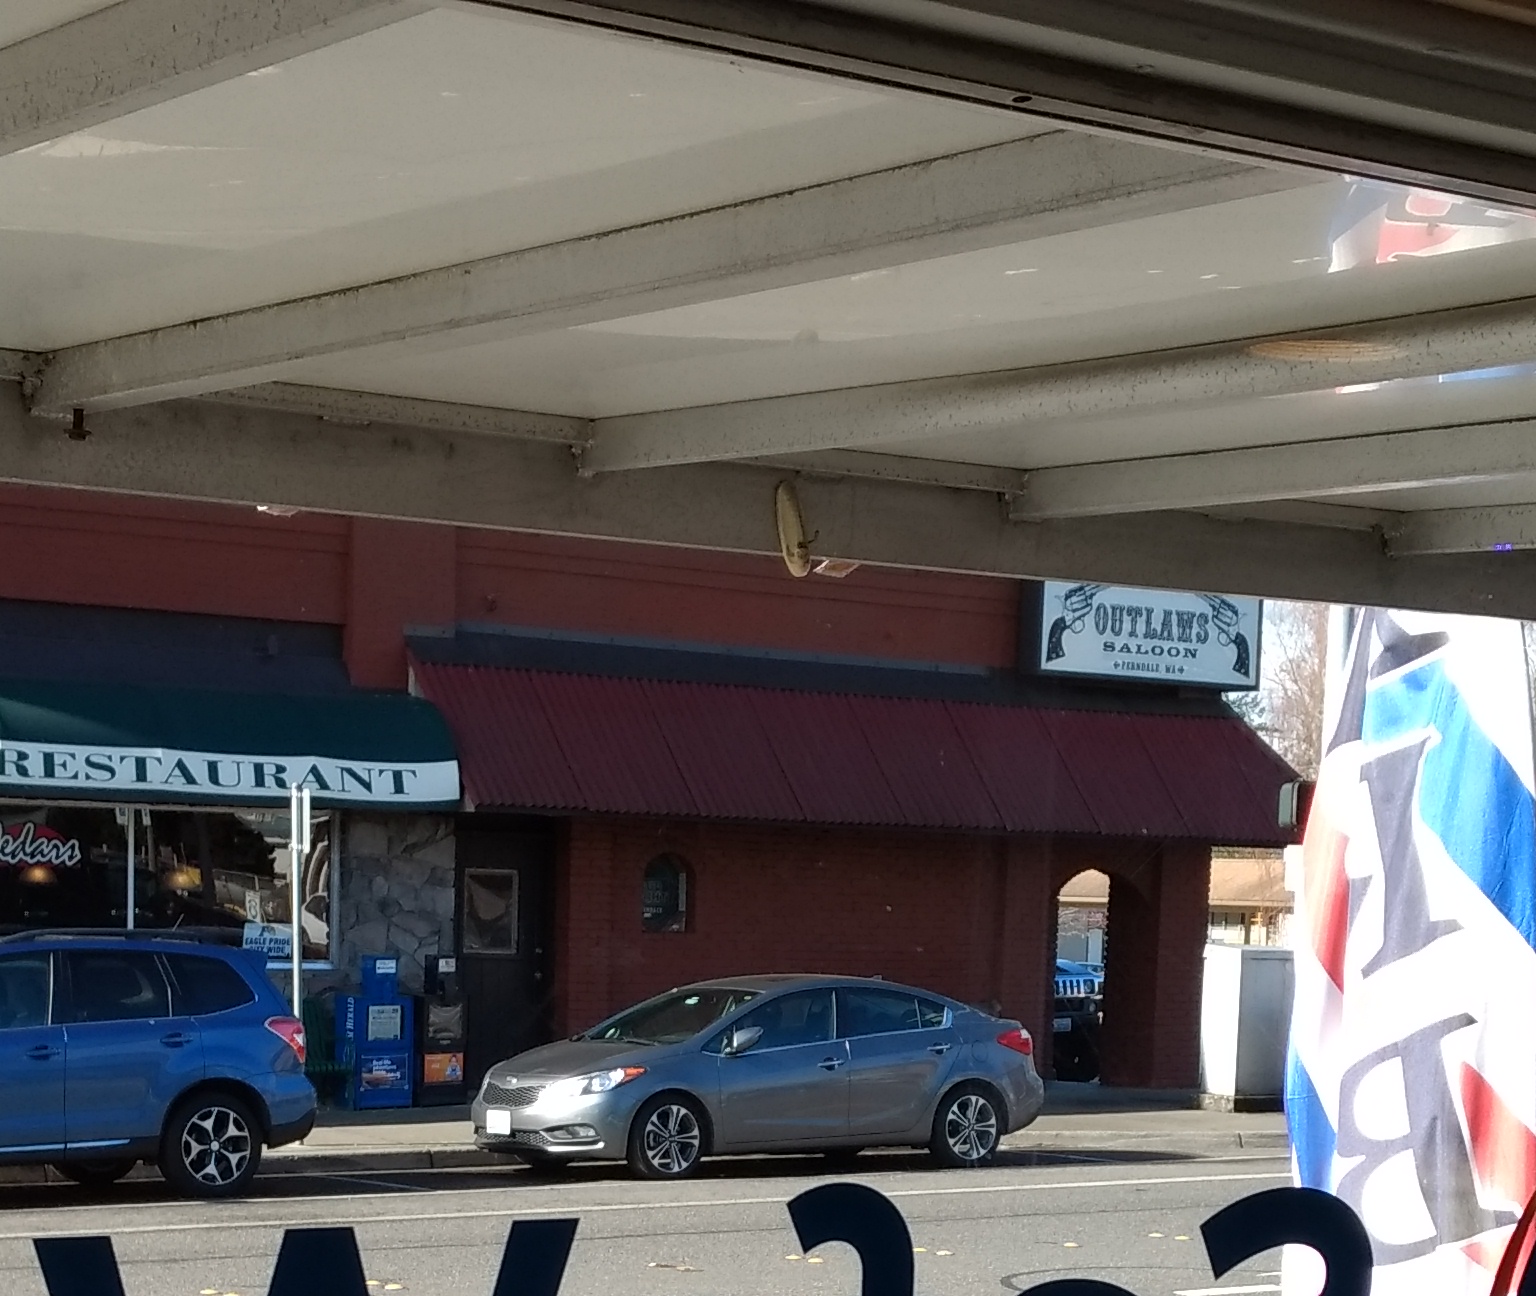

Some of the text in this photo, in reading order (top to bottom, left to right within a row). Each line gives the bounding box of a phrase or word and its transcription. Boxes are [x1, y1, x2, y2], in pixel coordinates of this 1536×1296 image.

[1094, 602, 1210, 645] OUTLAWS
[1103, 641, 1199, 659] SALOON
[1165, 664, 1176, 674] WA
[244, 937, 291, 946] EAGLE PRIDE
